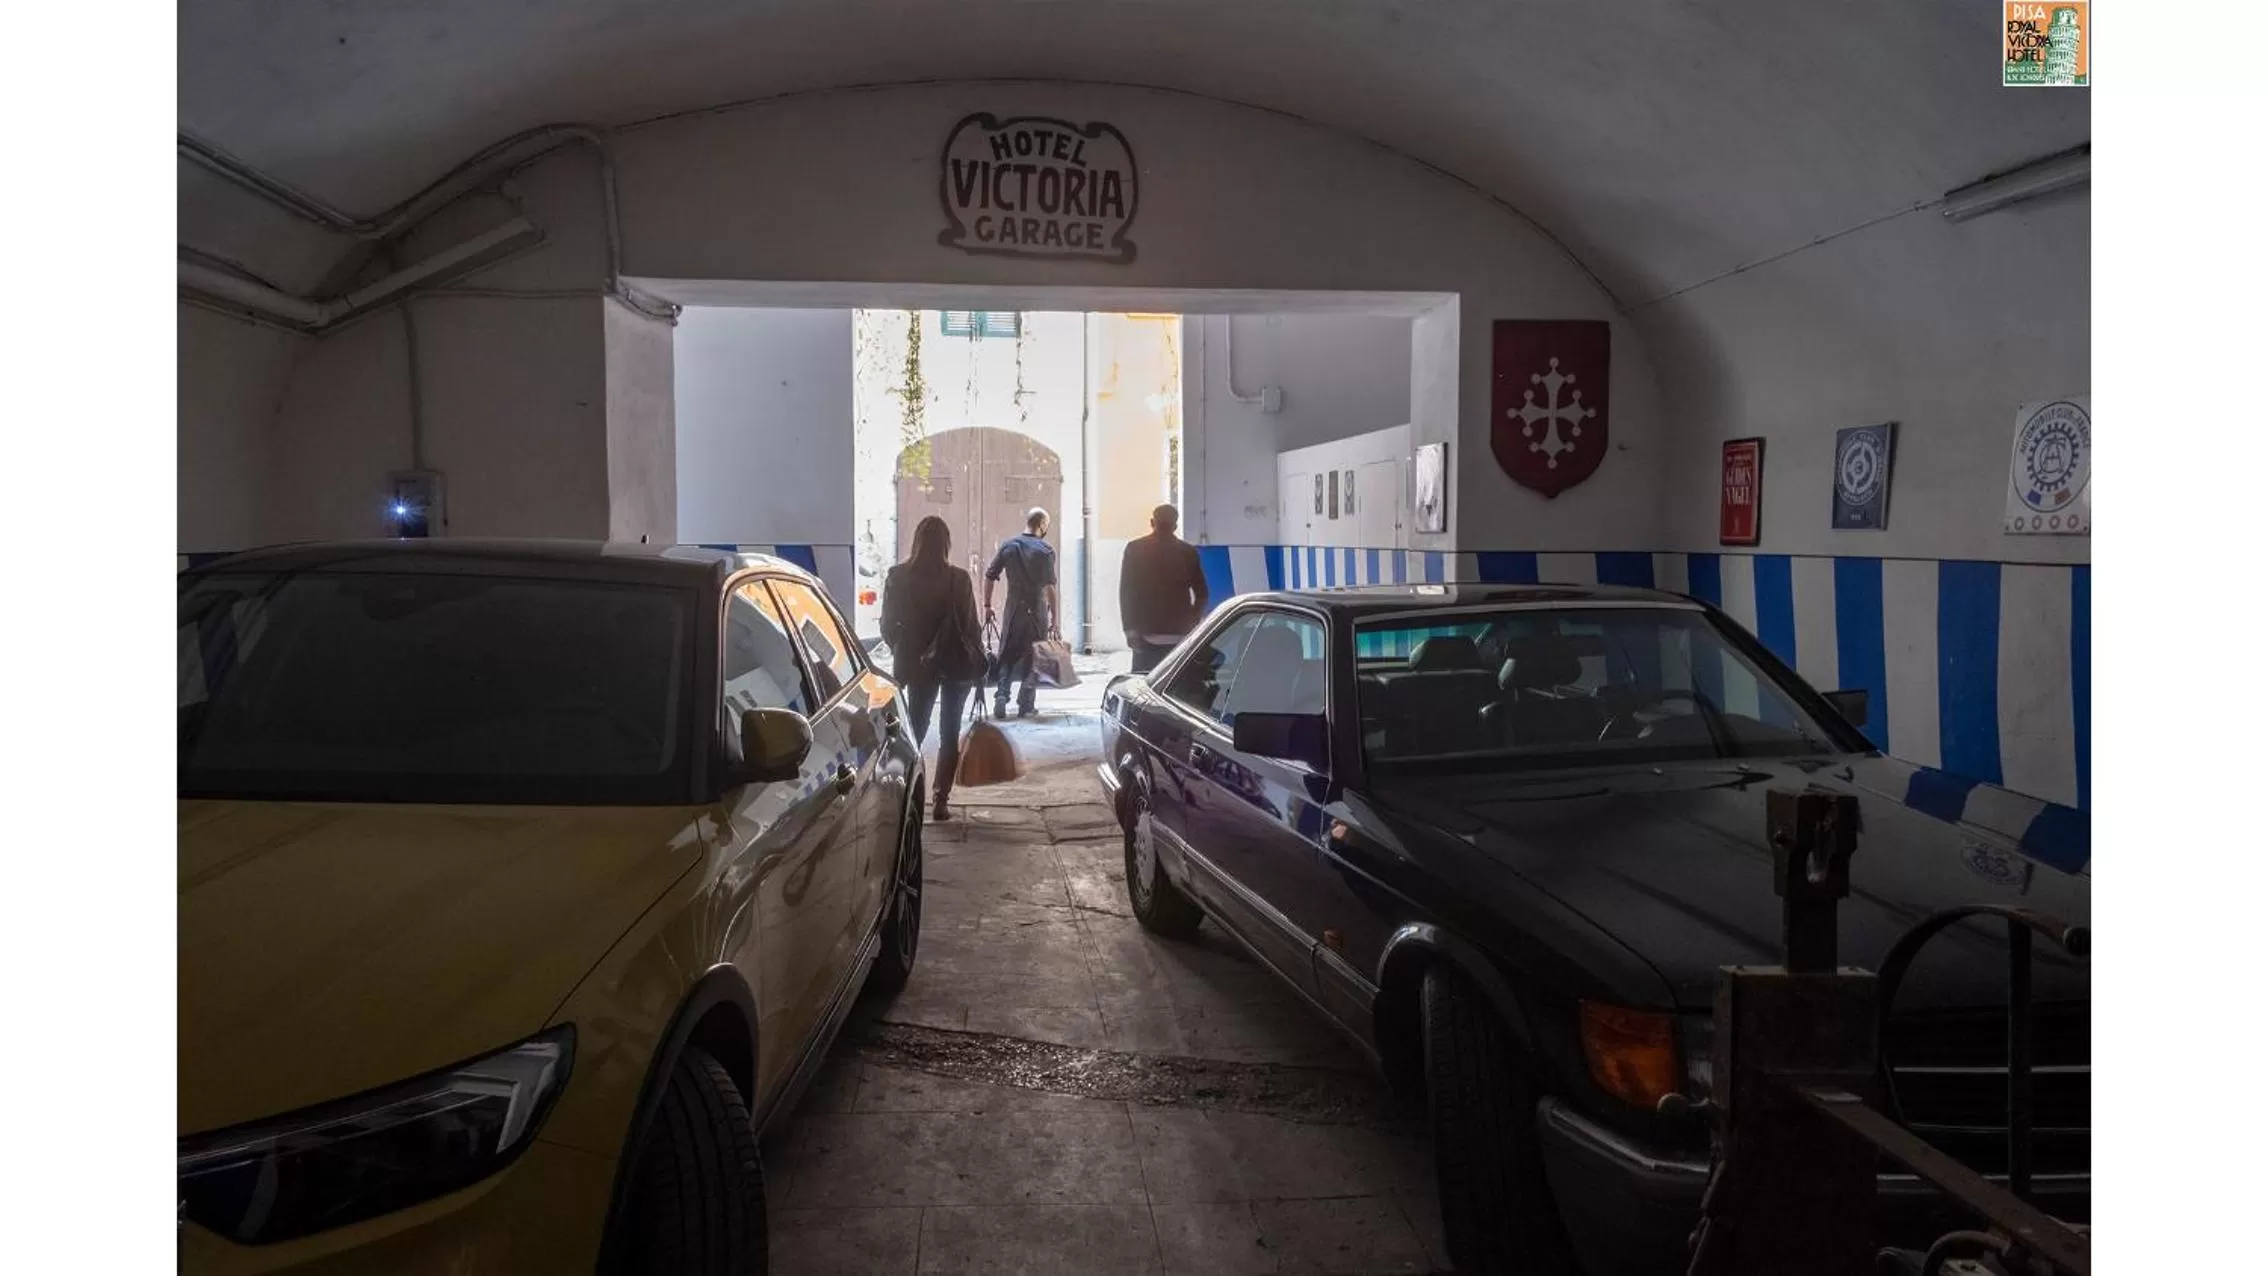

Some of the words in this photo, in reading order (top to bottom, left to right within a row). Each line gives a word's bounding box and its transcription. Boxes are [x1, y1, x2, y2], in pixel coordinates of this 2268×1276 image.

[989, 129, 1087, 168] HOTEL
[951, 158, 1125, 219] VICTORIA
[974, 215, 1105, 249] GARAGE
